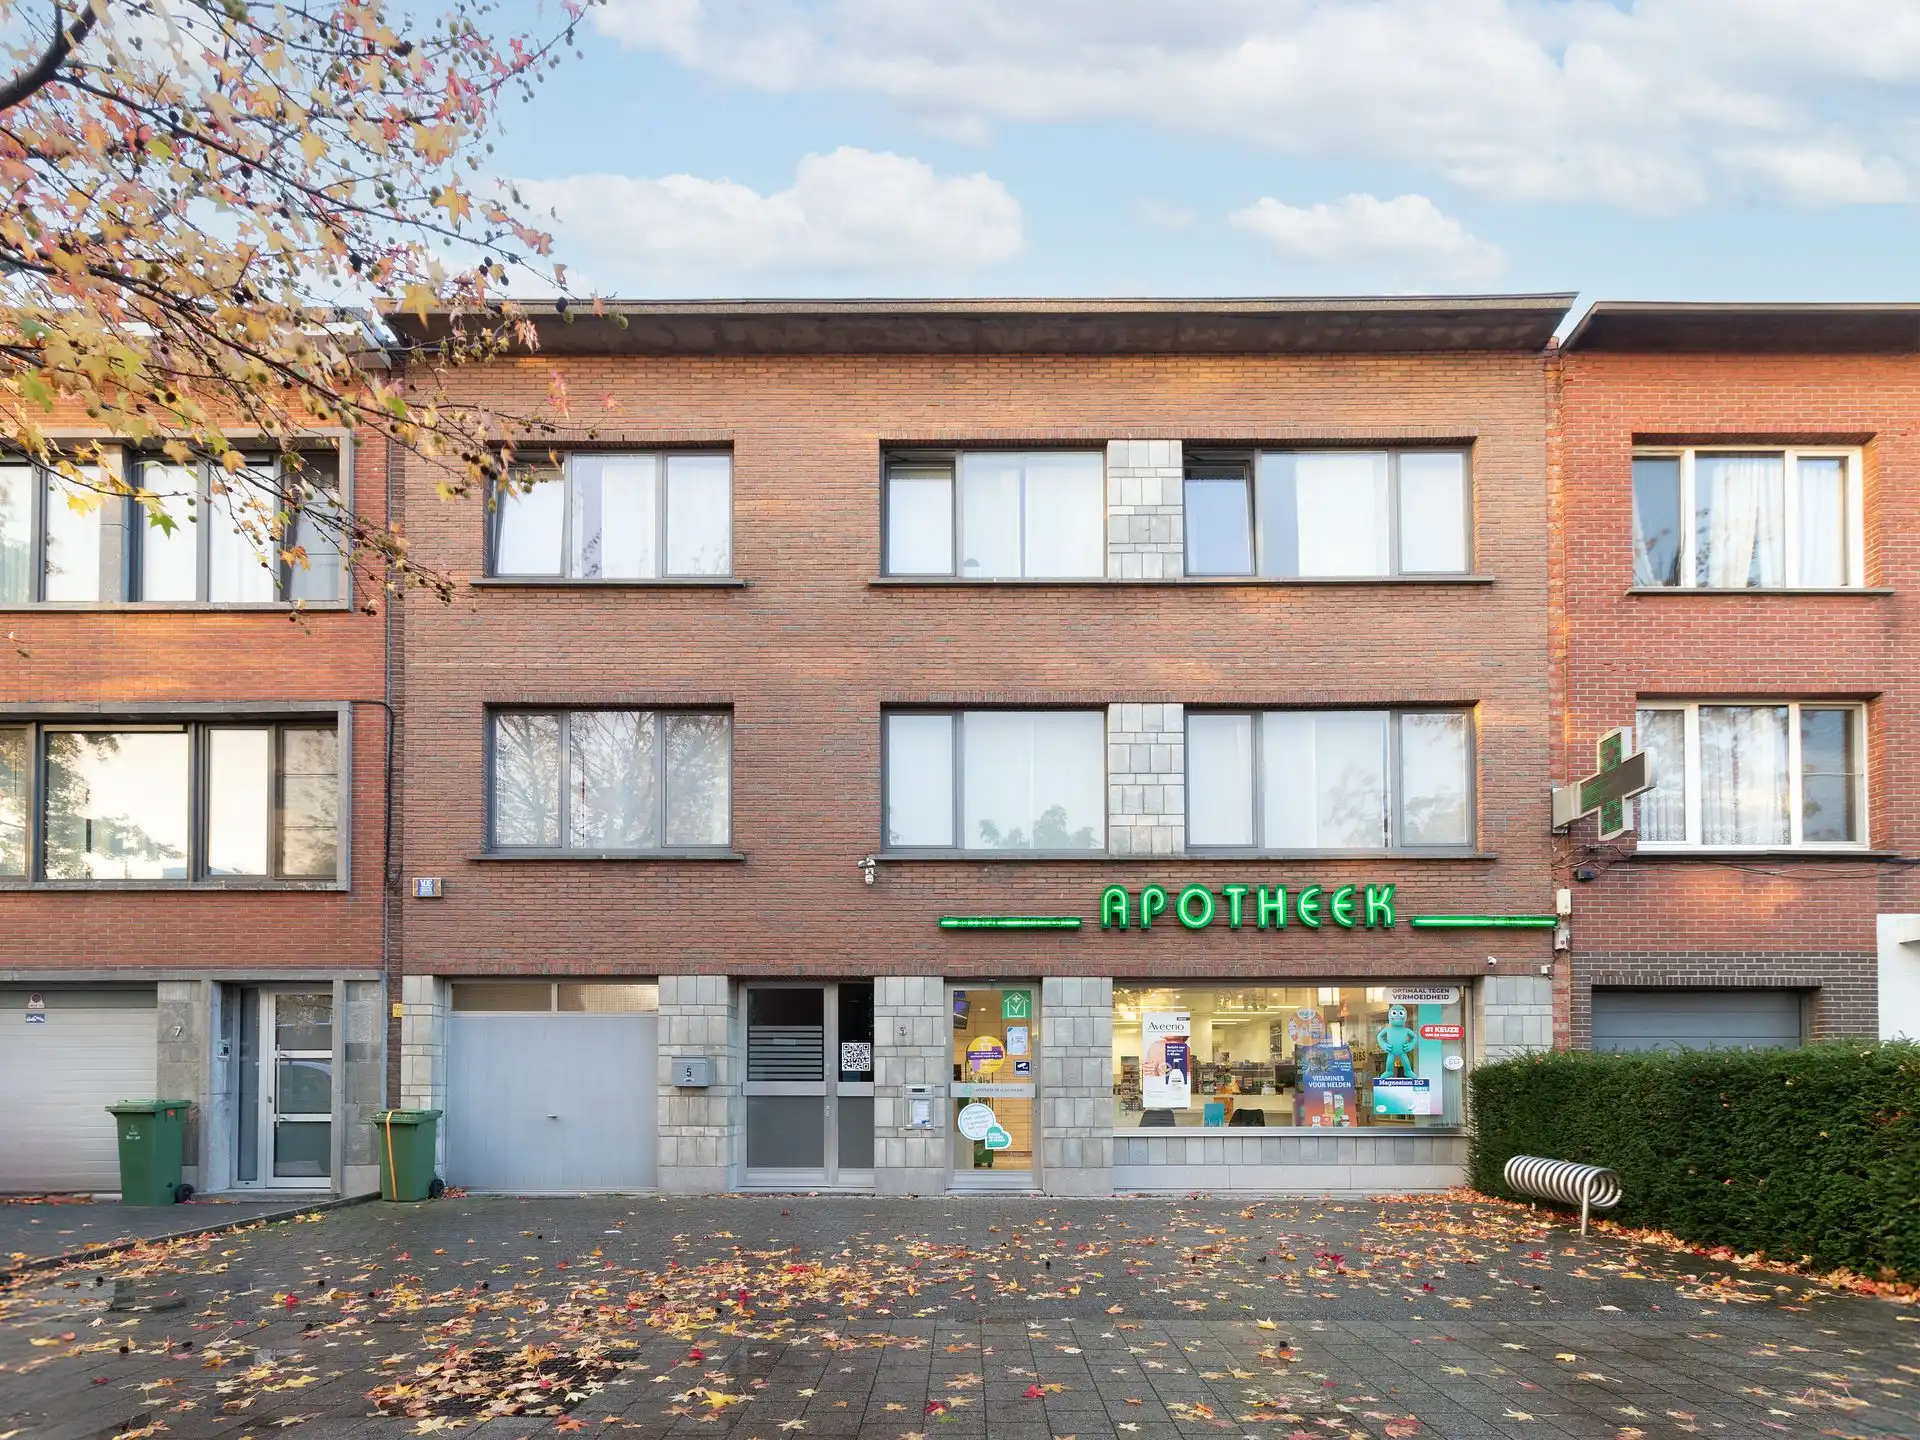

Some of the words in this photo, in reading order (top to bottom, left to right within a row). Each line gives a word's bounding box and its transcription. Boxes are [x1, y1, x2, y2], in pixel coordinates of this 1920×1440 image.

[1101, 884, 1396, 929] APOTHEEK
[1148, 1021, 1185, 1031] Aveeno
[174, 1026, 182, 1037] 7
[1353, 1051, 1366, 1061] BIBS
[686, 1067, 692, 1077] 5
